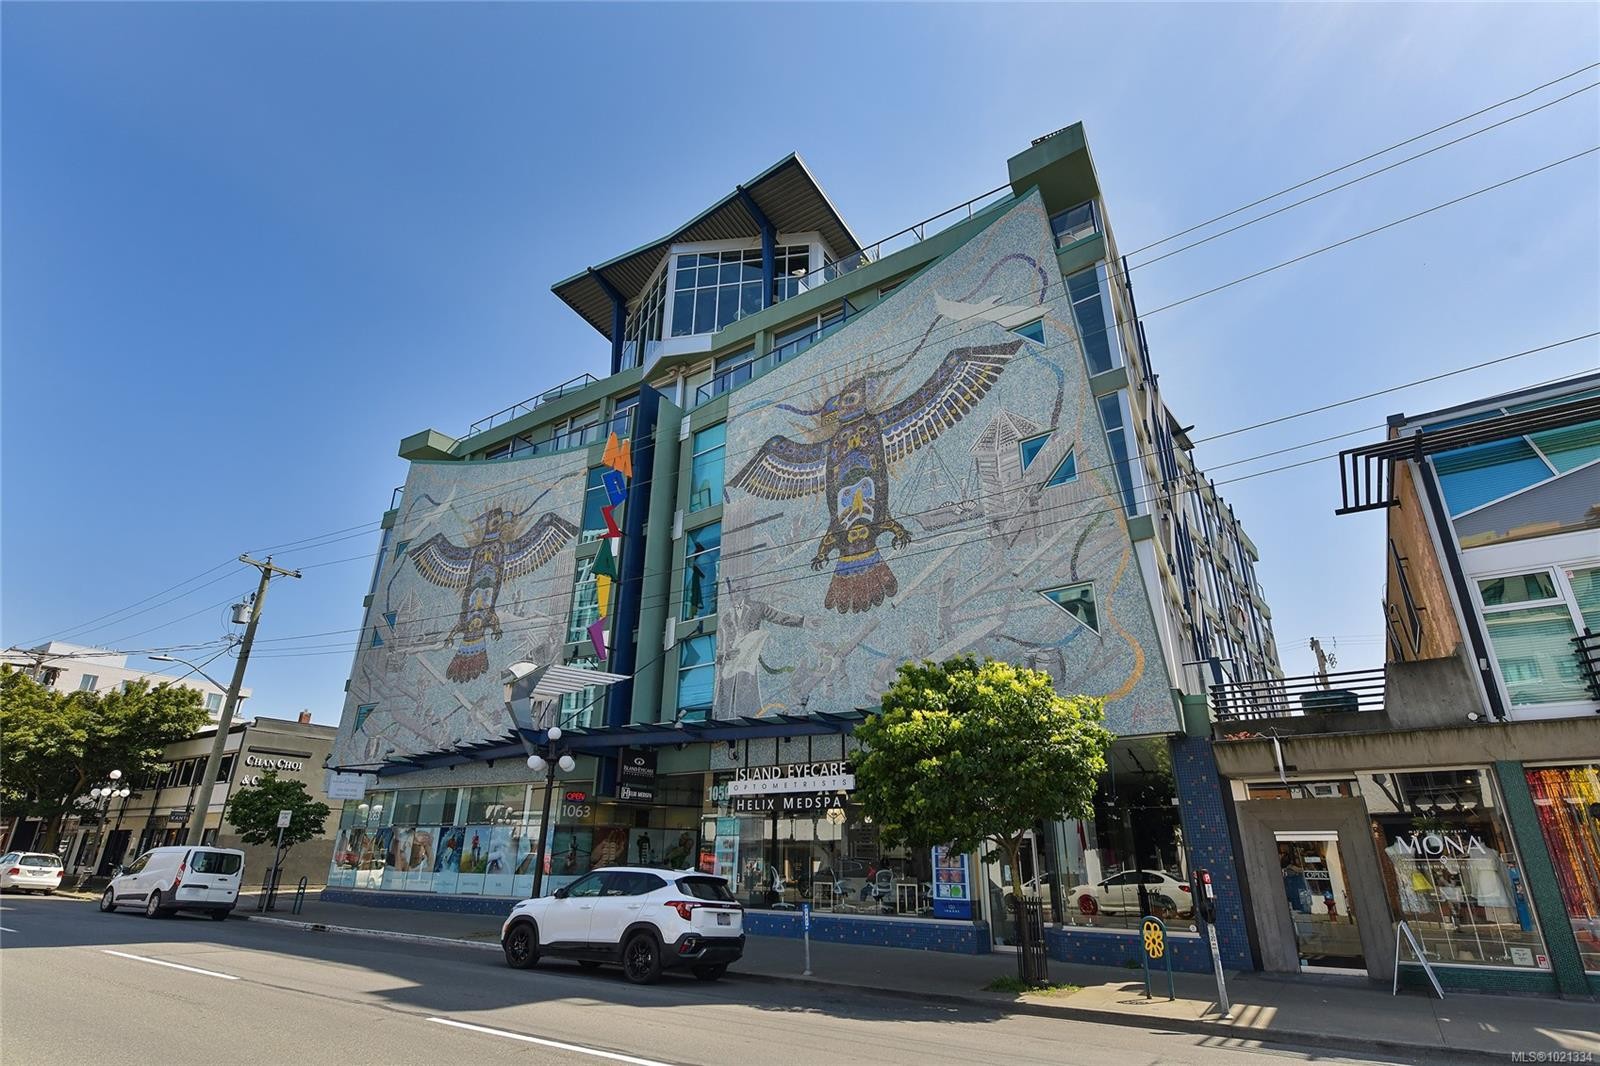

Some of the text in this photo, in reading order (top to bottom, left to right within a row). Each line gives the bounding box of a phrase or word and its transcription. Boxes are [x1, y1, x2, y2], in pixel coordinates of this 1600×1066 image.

[246, 755, 303, 770] CHAN CHOI
[736, 762, 847, 781] ISLAND EYECARE
[733, 779, 847, 791] OPTOMETRISTS
[562, 804, 591, 818] 1063
[737, 796, 841, 811] HELIX MEDSPA
[1395, 834, 1487, 855] MONA
